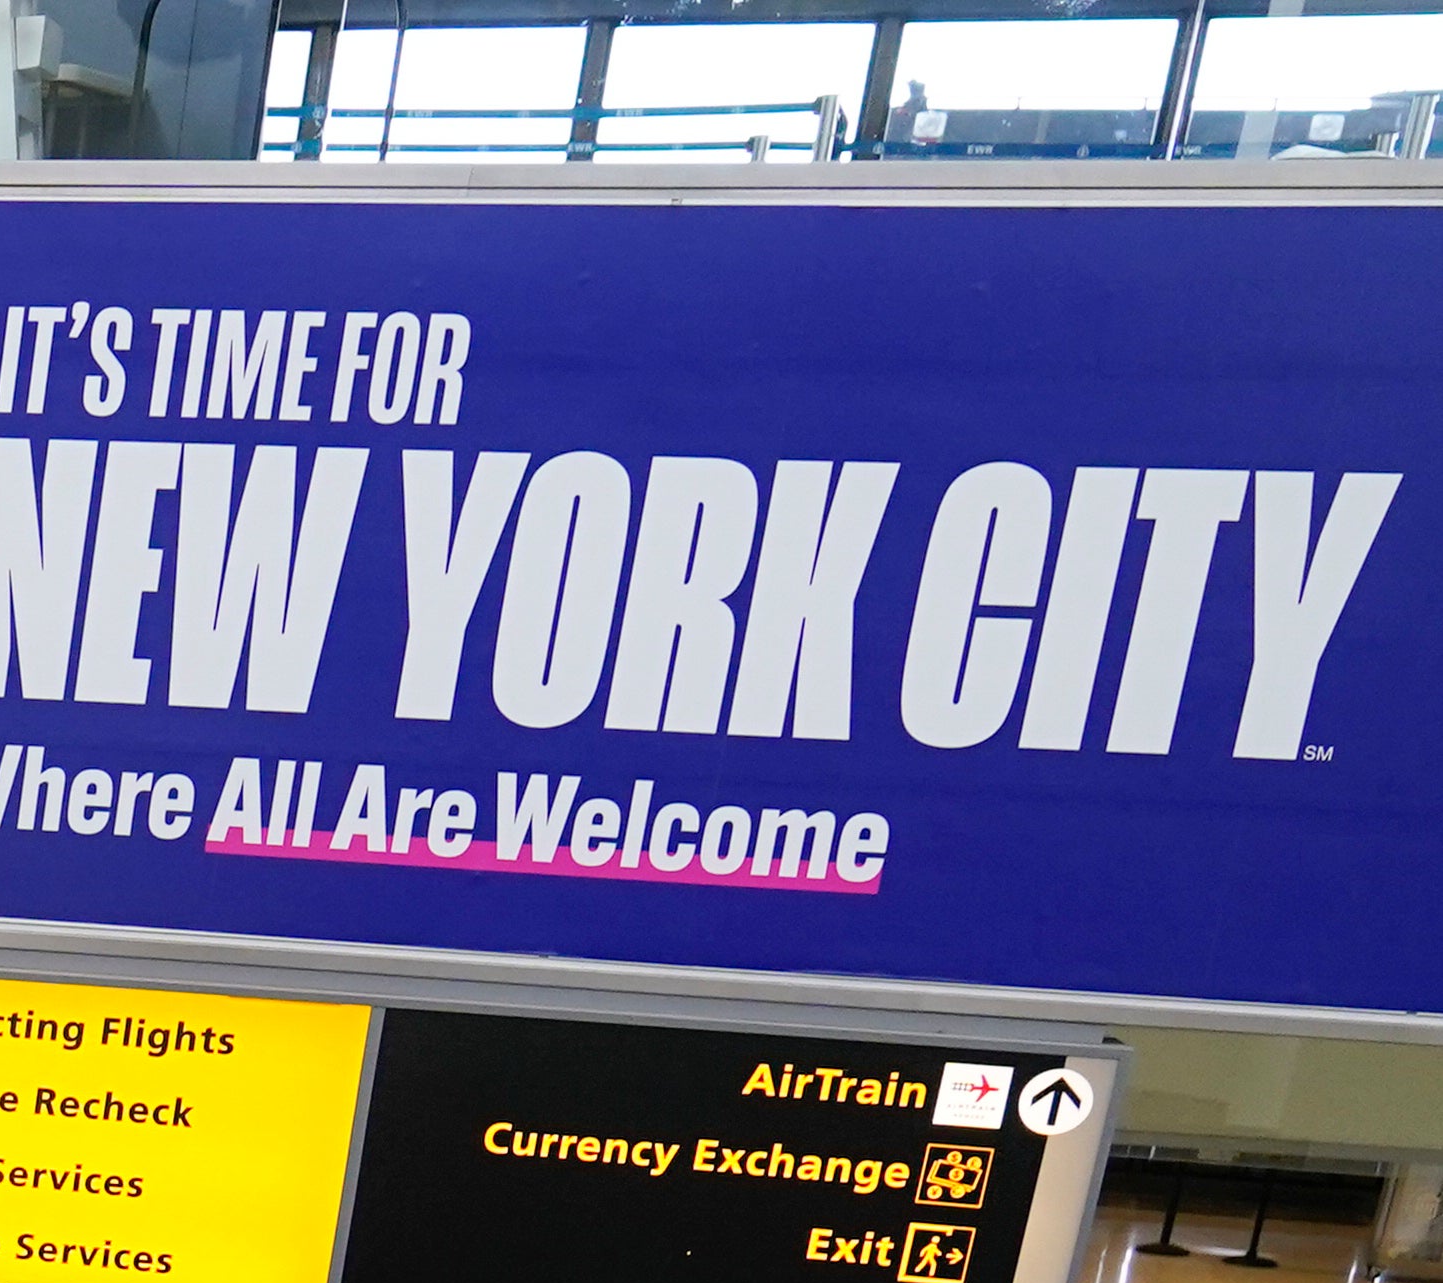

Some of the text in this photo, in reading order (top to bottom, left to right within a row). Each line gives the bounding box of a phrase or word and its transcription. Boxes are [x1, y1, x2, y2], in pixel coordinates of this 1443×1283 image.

[150, 309, 326, 420] TIME
[331, 312, 470, 424] FOR
[395, 450, 900, 740] YORK
[901, 462, 1403, 759] CITY
[1303, 744, 1334, 761] SM
[207, 758, 322, 847] All
[330, 765, 476, 857] Are
[497, 773, 889, 882] Welcome
[100, 1016, 236, 1057] Flights
[34, 1088, 194, 1128] Recheck
[742, 1063, 927, 1109] AirTrain
[483, 1121, 911, 1195] Currency Exchange
[15, 1233, 173, 1275] Services
[805, 1227, 894, 1267] Exit
